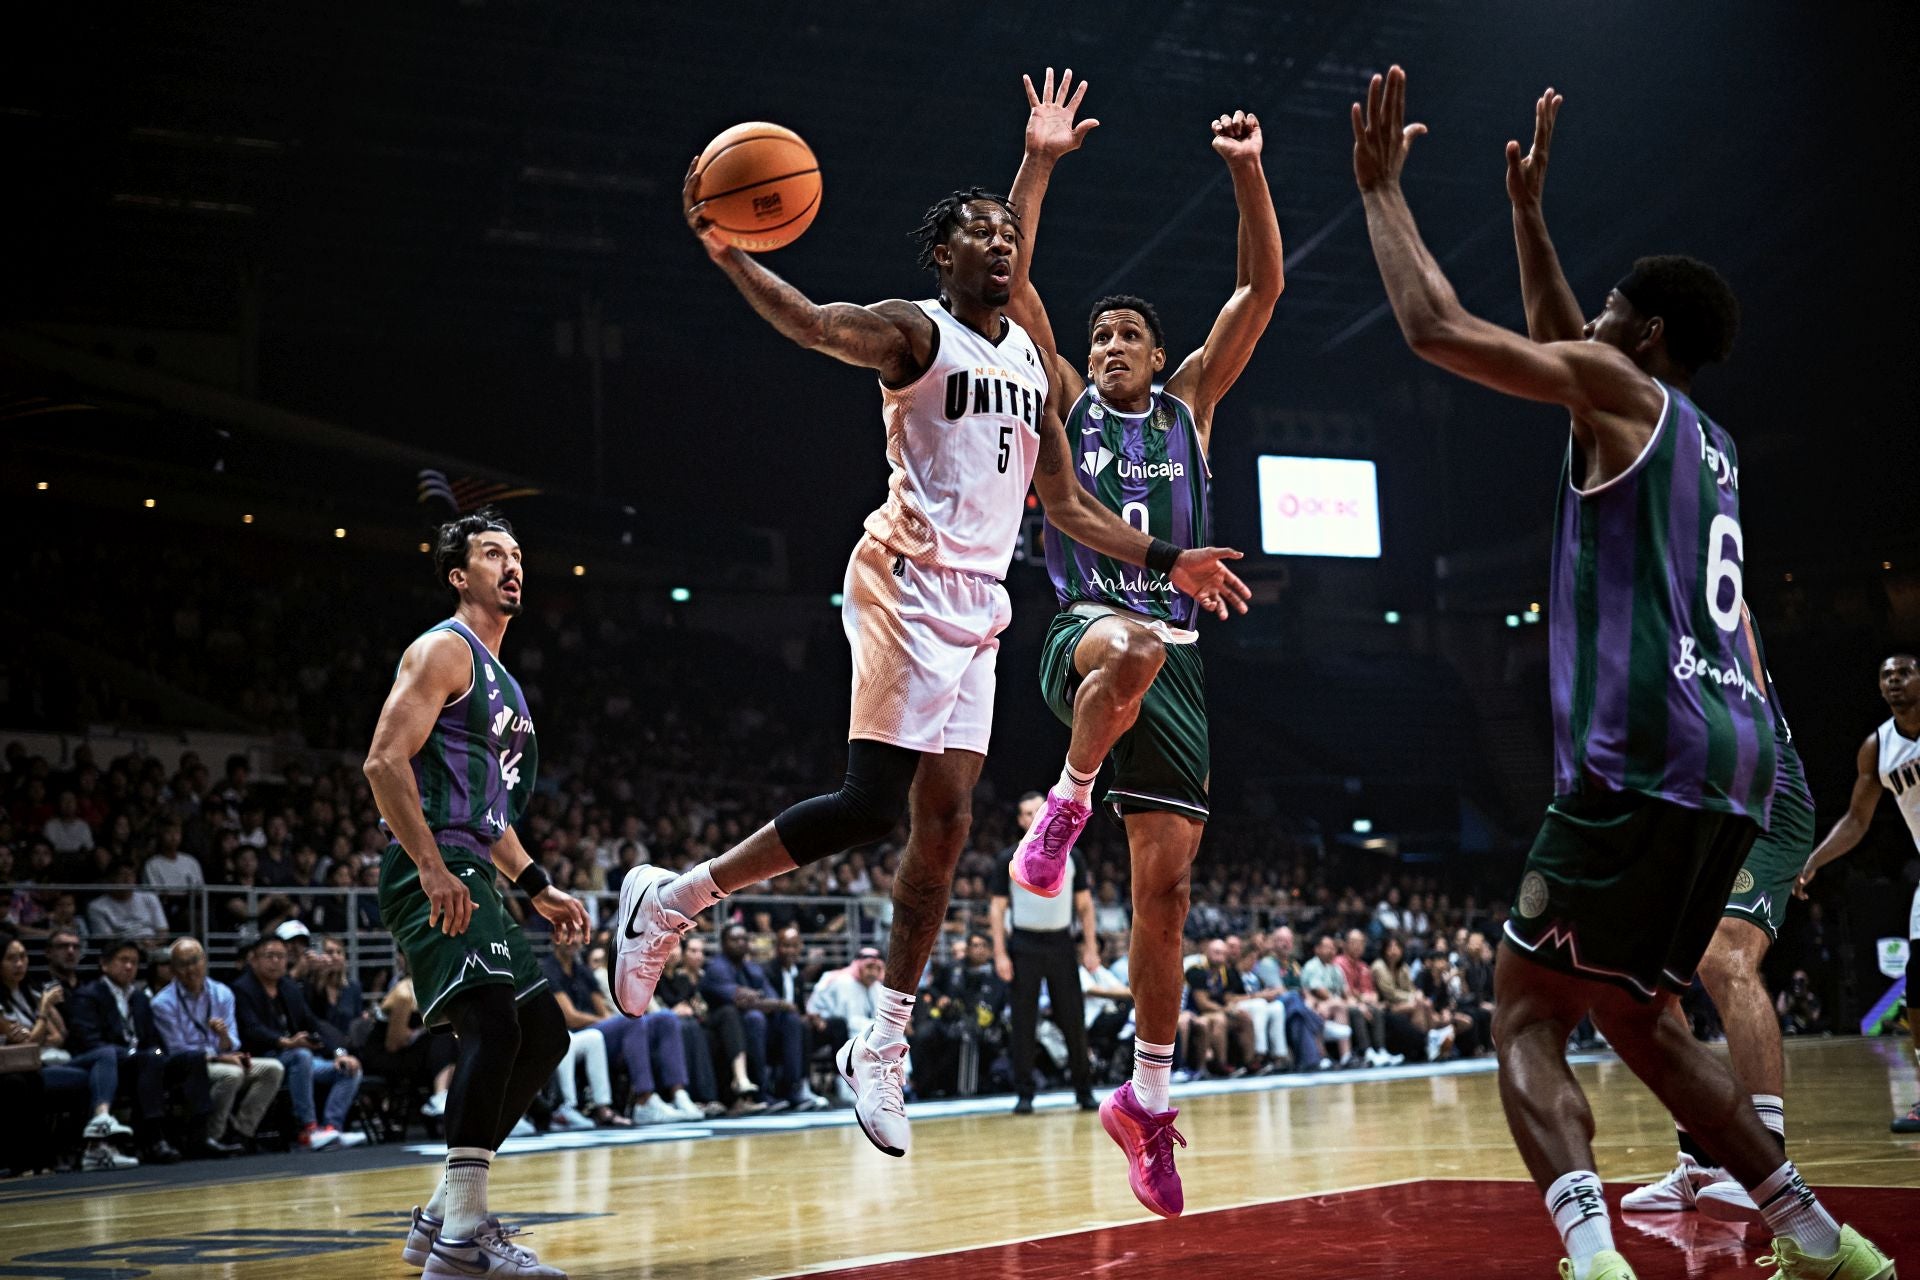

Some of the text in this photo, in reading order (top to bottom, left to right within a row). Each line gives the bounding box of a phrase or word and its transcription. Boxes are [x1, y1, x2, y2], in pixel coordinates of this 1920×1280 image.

[998, 426, 1013, 474] 5
[1117, 459, 1184, 481] Unicaja
[1088, 567, 1179, 595] Andalucía
[1706, 514, 1744, 632] 6
